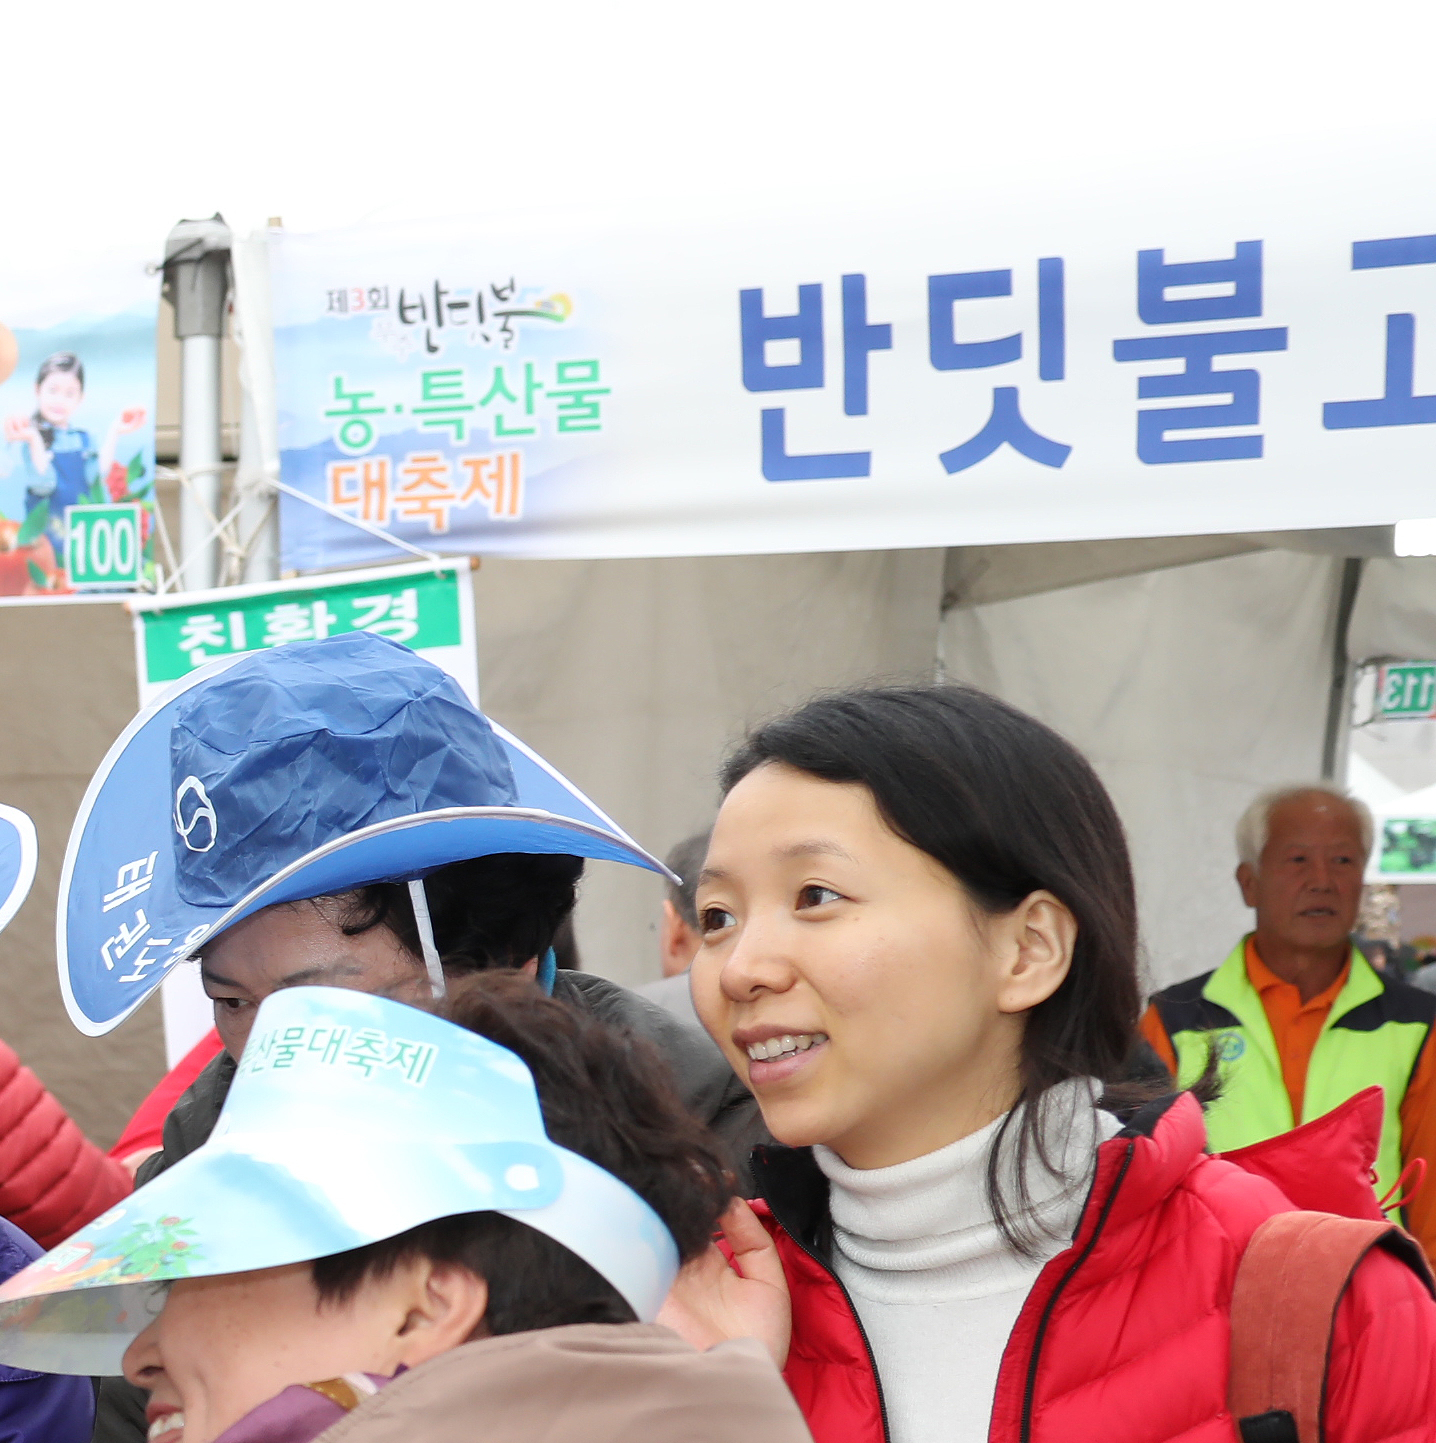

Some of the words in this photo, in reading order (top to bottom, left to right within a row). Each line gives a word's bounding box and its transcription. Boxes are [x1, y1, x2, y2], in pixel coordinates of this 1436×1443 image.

[332, 453, 520, 530] 대축제
[70, 519, 135, 577] 100
[178, 588, 419, 668] 친환경
